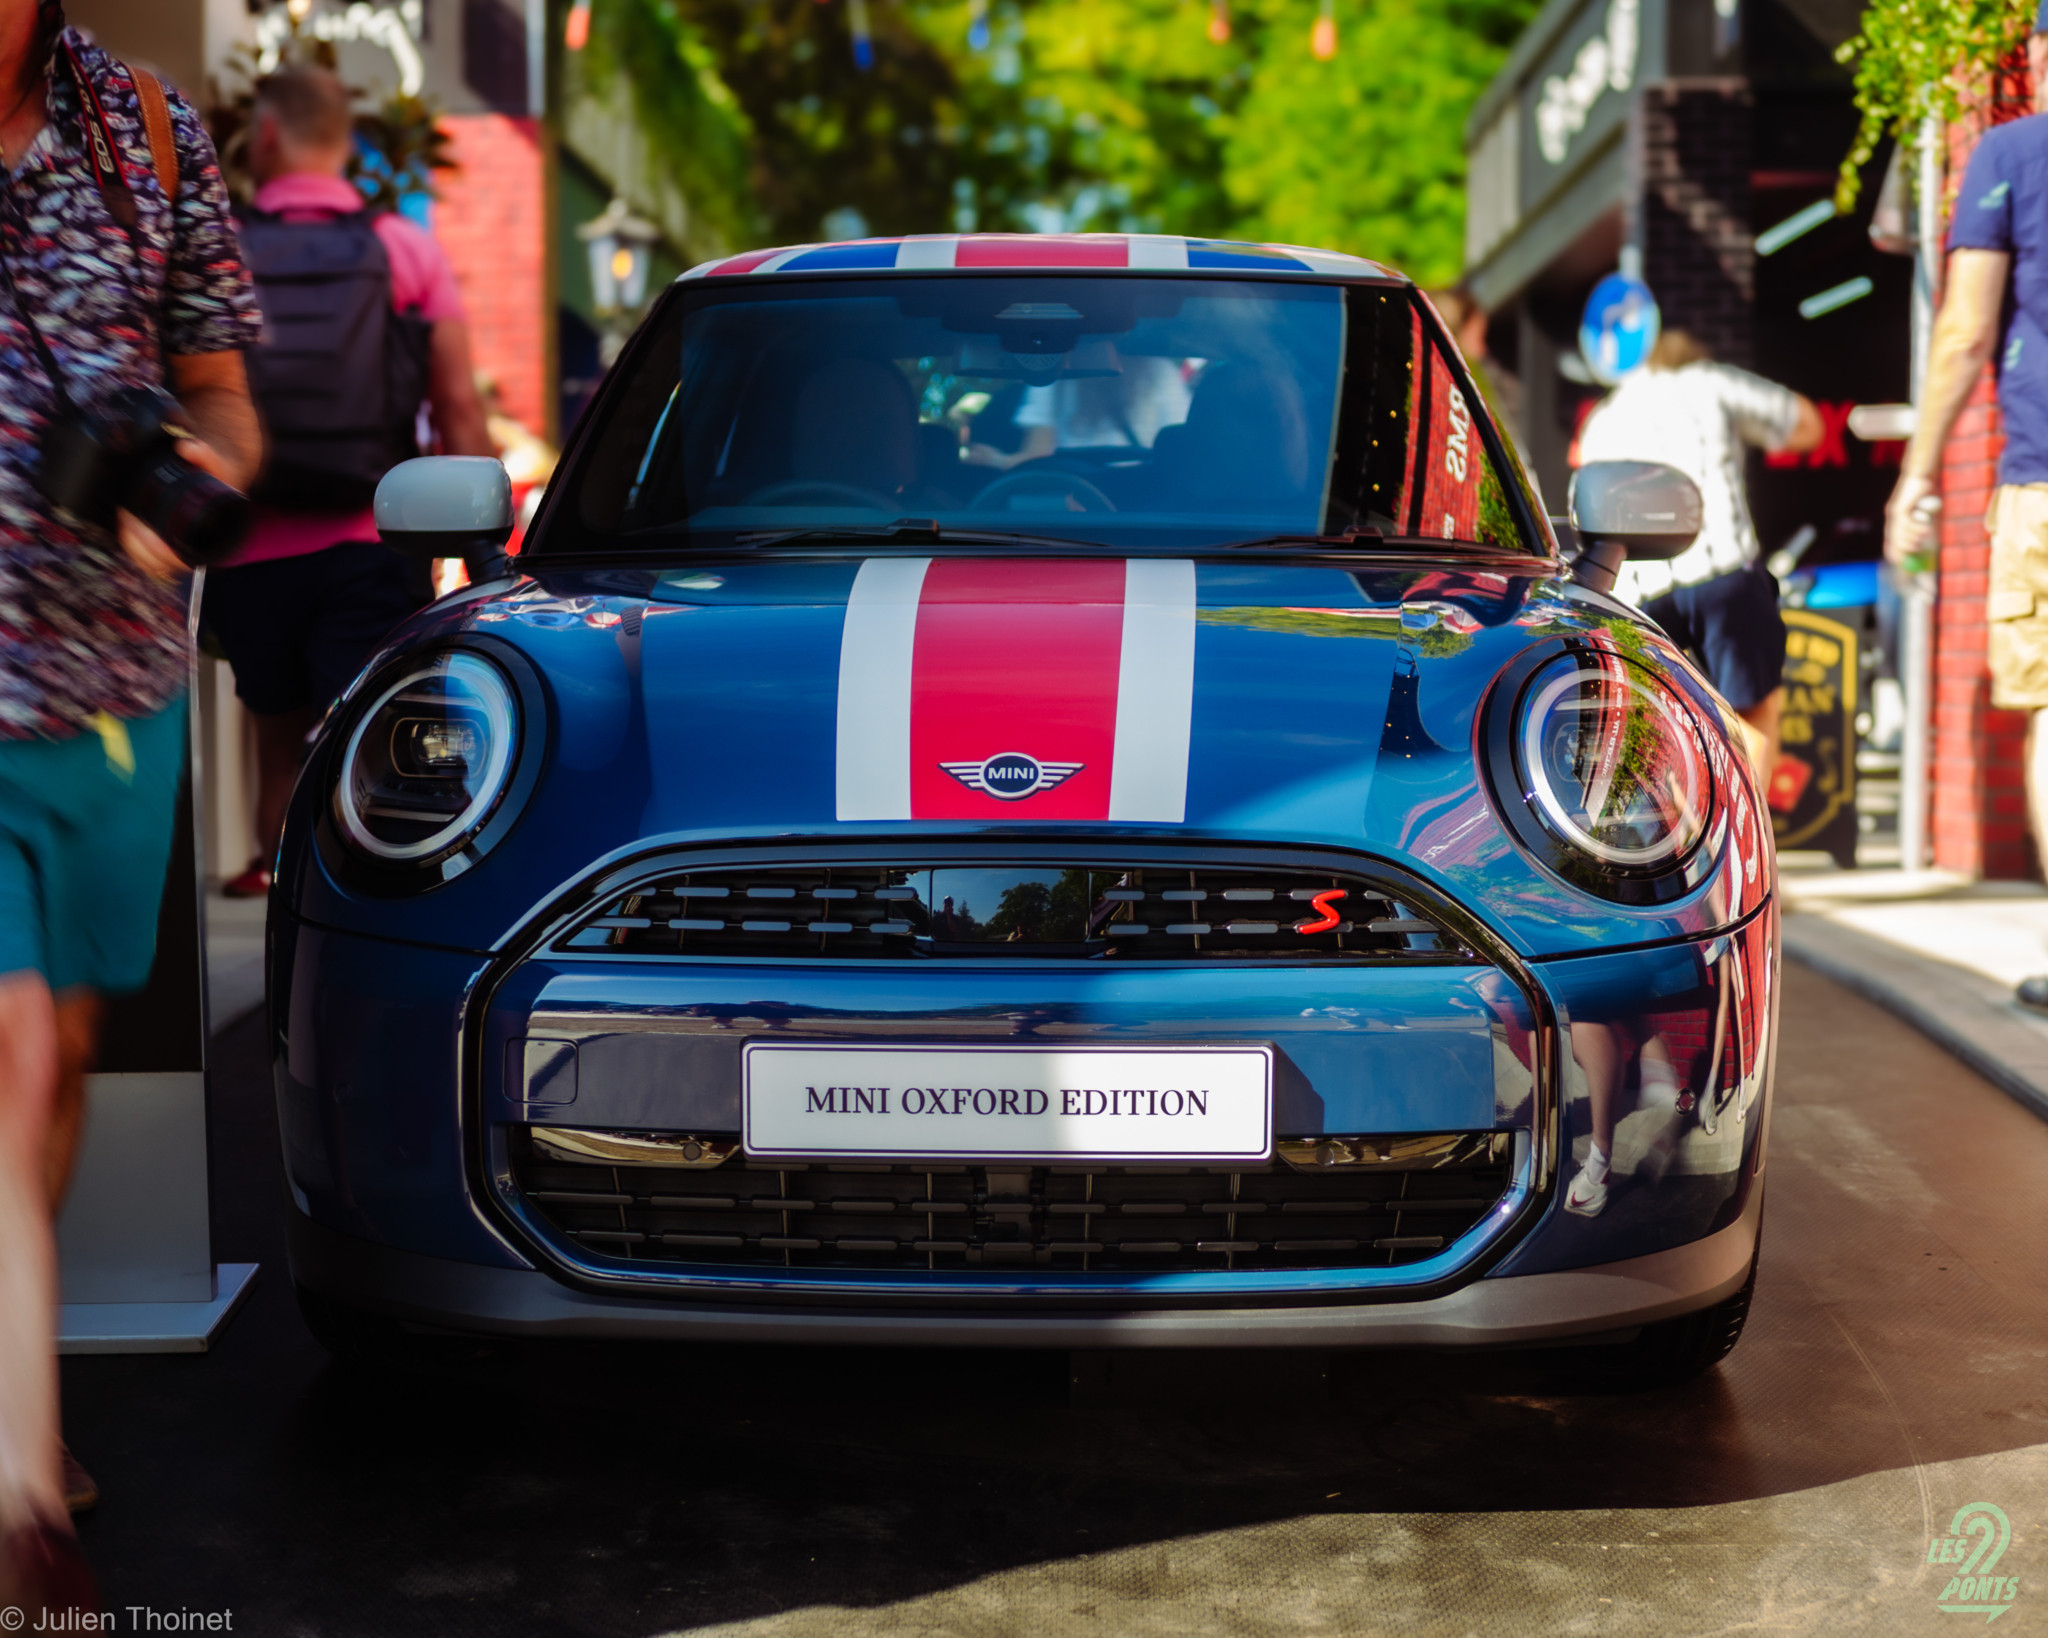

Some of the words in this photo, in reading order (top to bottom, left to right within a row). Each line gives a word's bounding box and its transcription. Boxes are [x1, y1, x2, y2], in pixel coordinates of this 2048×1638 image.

[89, 122, 115, 173] EOS
[988, 767, 1034, 780] MINI
[1299, 889, 1346, 935] S
[806, 1087, 891, 1114] MINI
[901, 1088, 1049, 1115] OXFORD
[1060, 1089, 1210, 1116] EDITION
